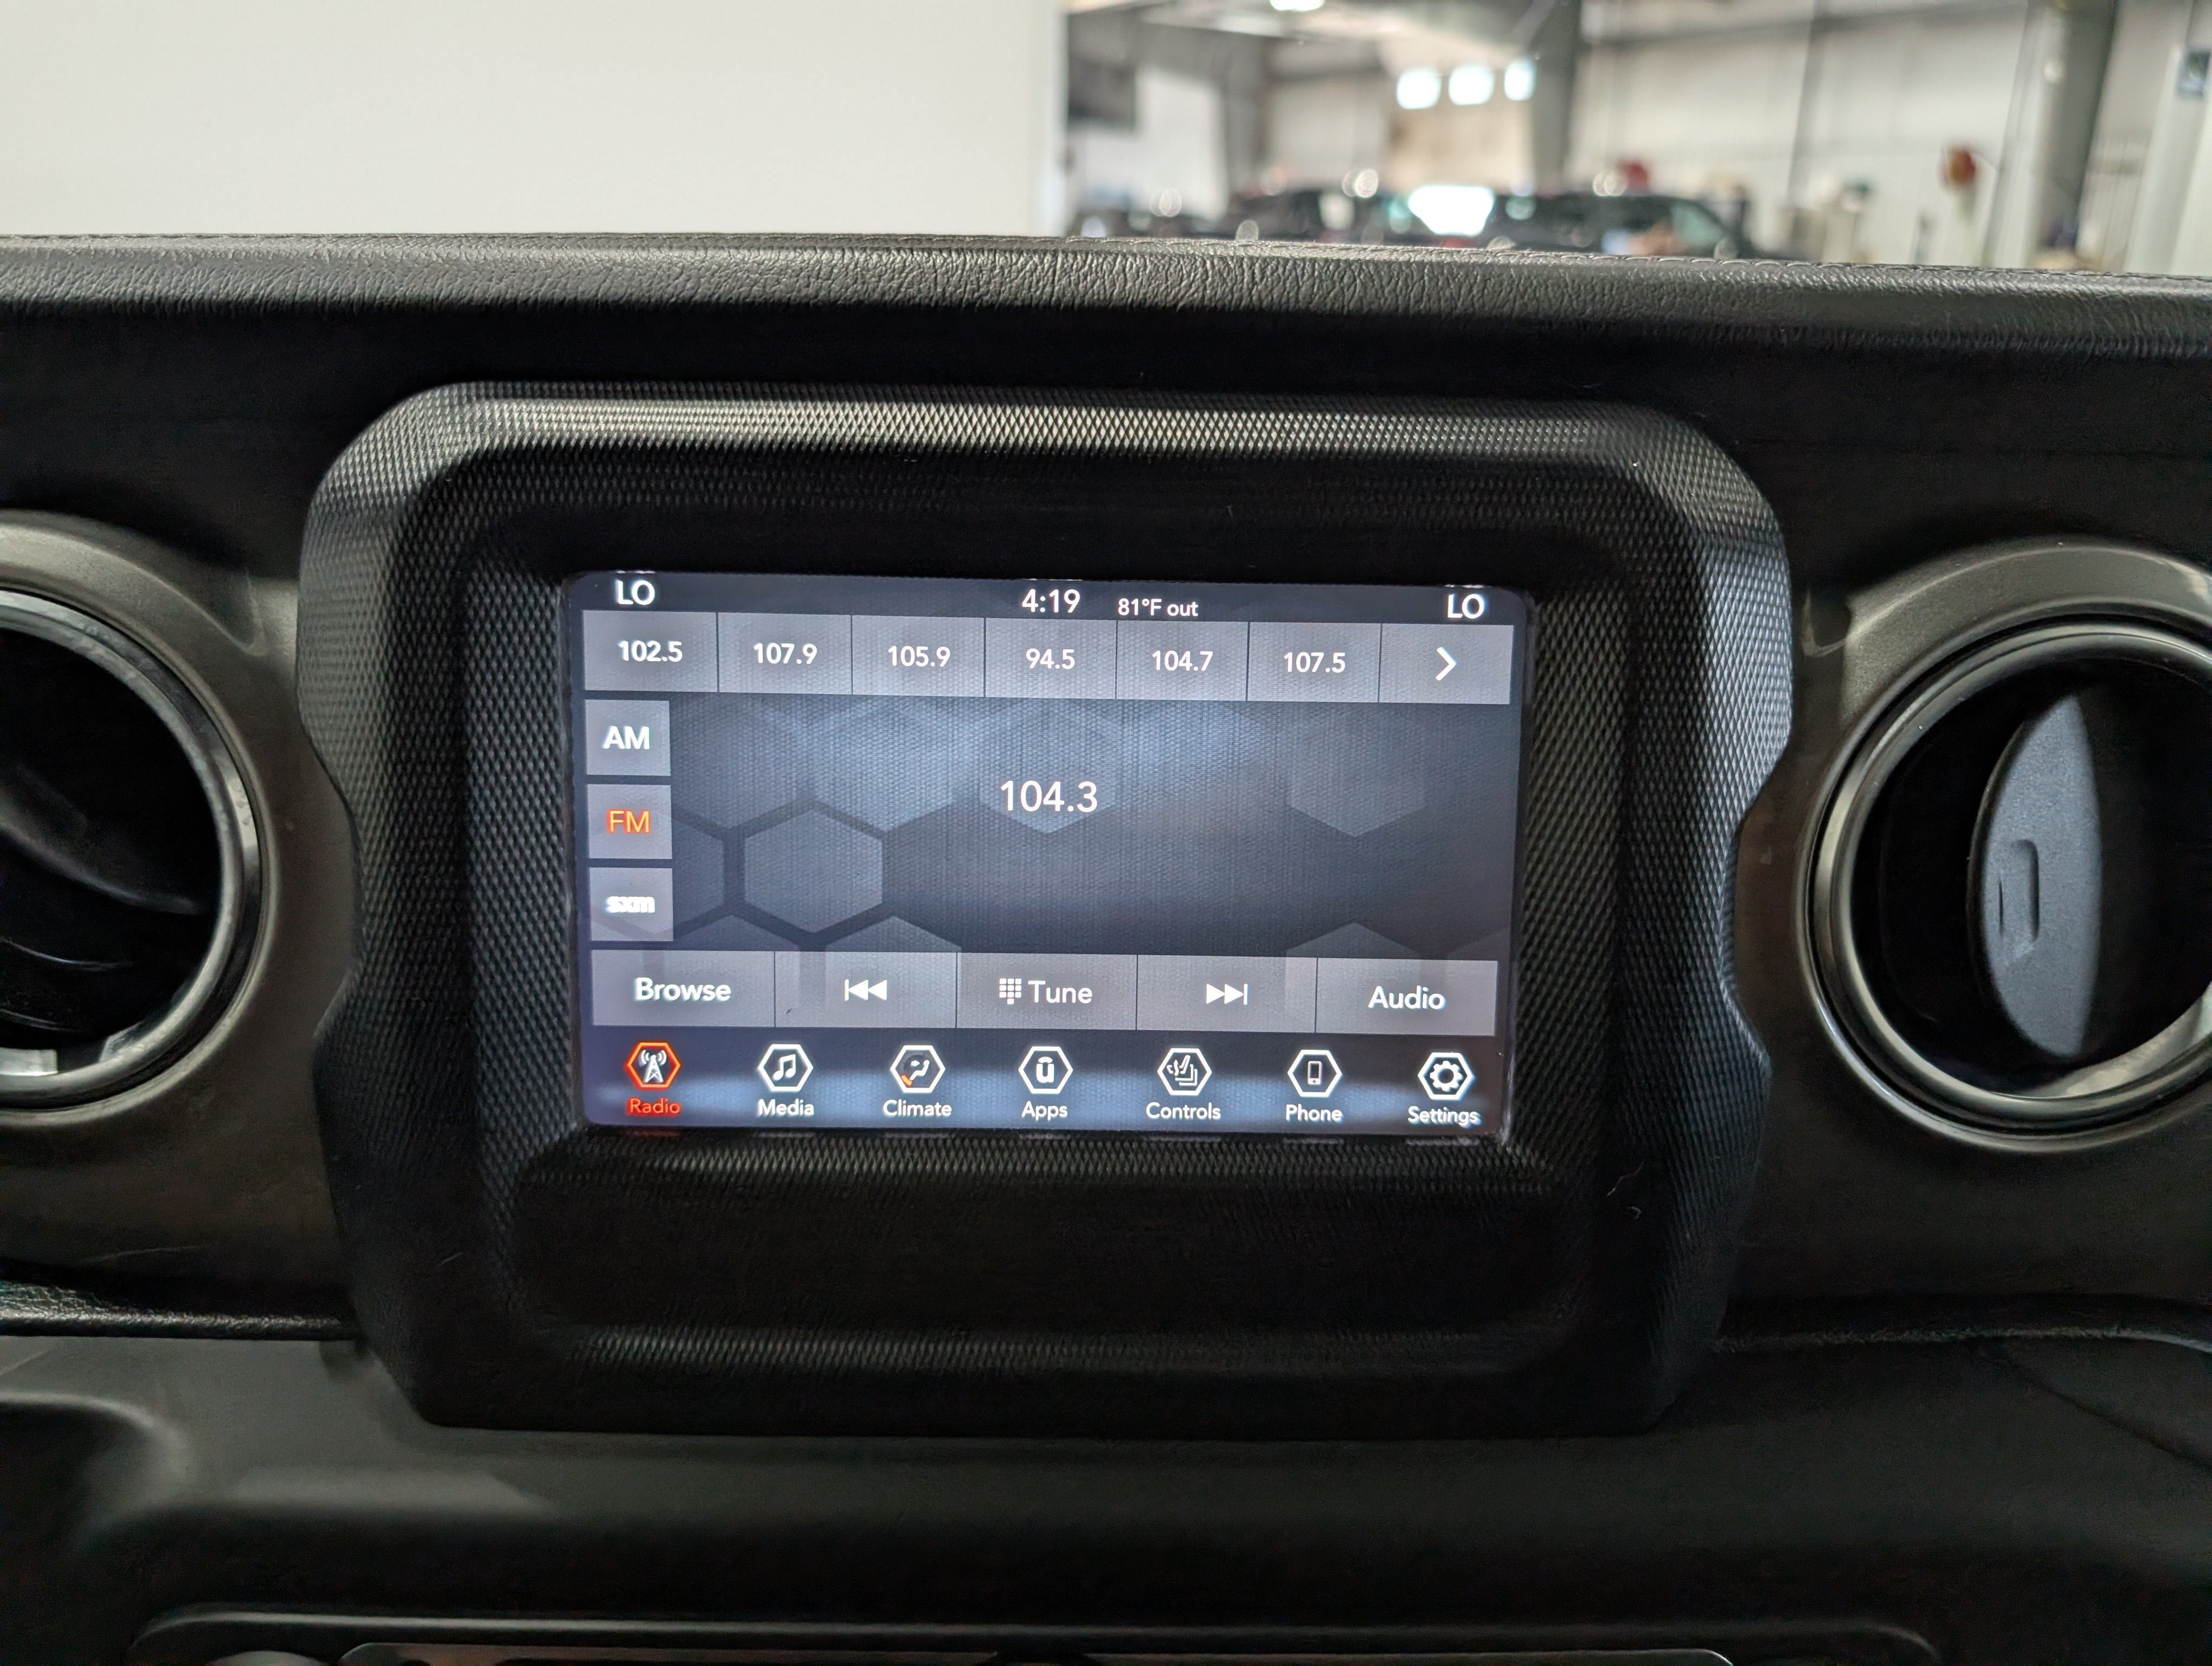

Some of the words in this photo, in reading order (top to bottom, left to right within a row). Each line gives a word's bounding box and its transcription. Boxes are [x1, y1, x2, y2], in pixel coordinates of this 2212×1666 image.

[615, 579, 655, 606] LO
[1021, 588, 1081, 613] 4:19
[1117, 598, 1162, 617] 81°F
[1167, 601, 1199, 617] out
[1446, 593, 1486, 619] LO
[618, 640, 683, 663] 102.5
[753, 643, 818, 665] 107.9
[888, 645, 951, 668] 105.9
[1025, 648, 1076, 670] 94.5
[1151, 650, 1213, 672] 104.7
[1283, 651, 1346, 674] 107.5
[602, 725, 651, 751] AM
[1000, 780, 1098, 813] 104.3
[607, 809, 652, 835] FM
[634, 977, 732, 1003] Browse
[1028, 981, 1093, 1004] Tune
[1368, 985, 1446, 1010] Audio
[629, 1098, 681, 1116] Radio
[758, 1099, 815, 1118] Media
[882, 1099, 953, 1118] Climate
[1021, 1101, 1068, 1120] Apps
[1145, 1102, 1222, 1120] Controls
[1285, 1104, 1343, 1123] Phone
[1407, 1105, 1481, 1127] Settings
